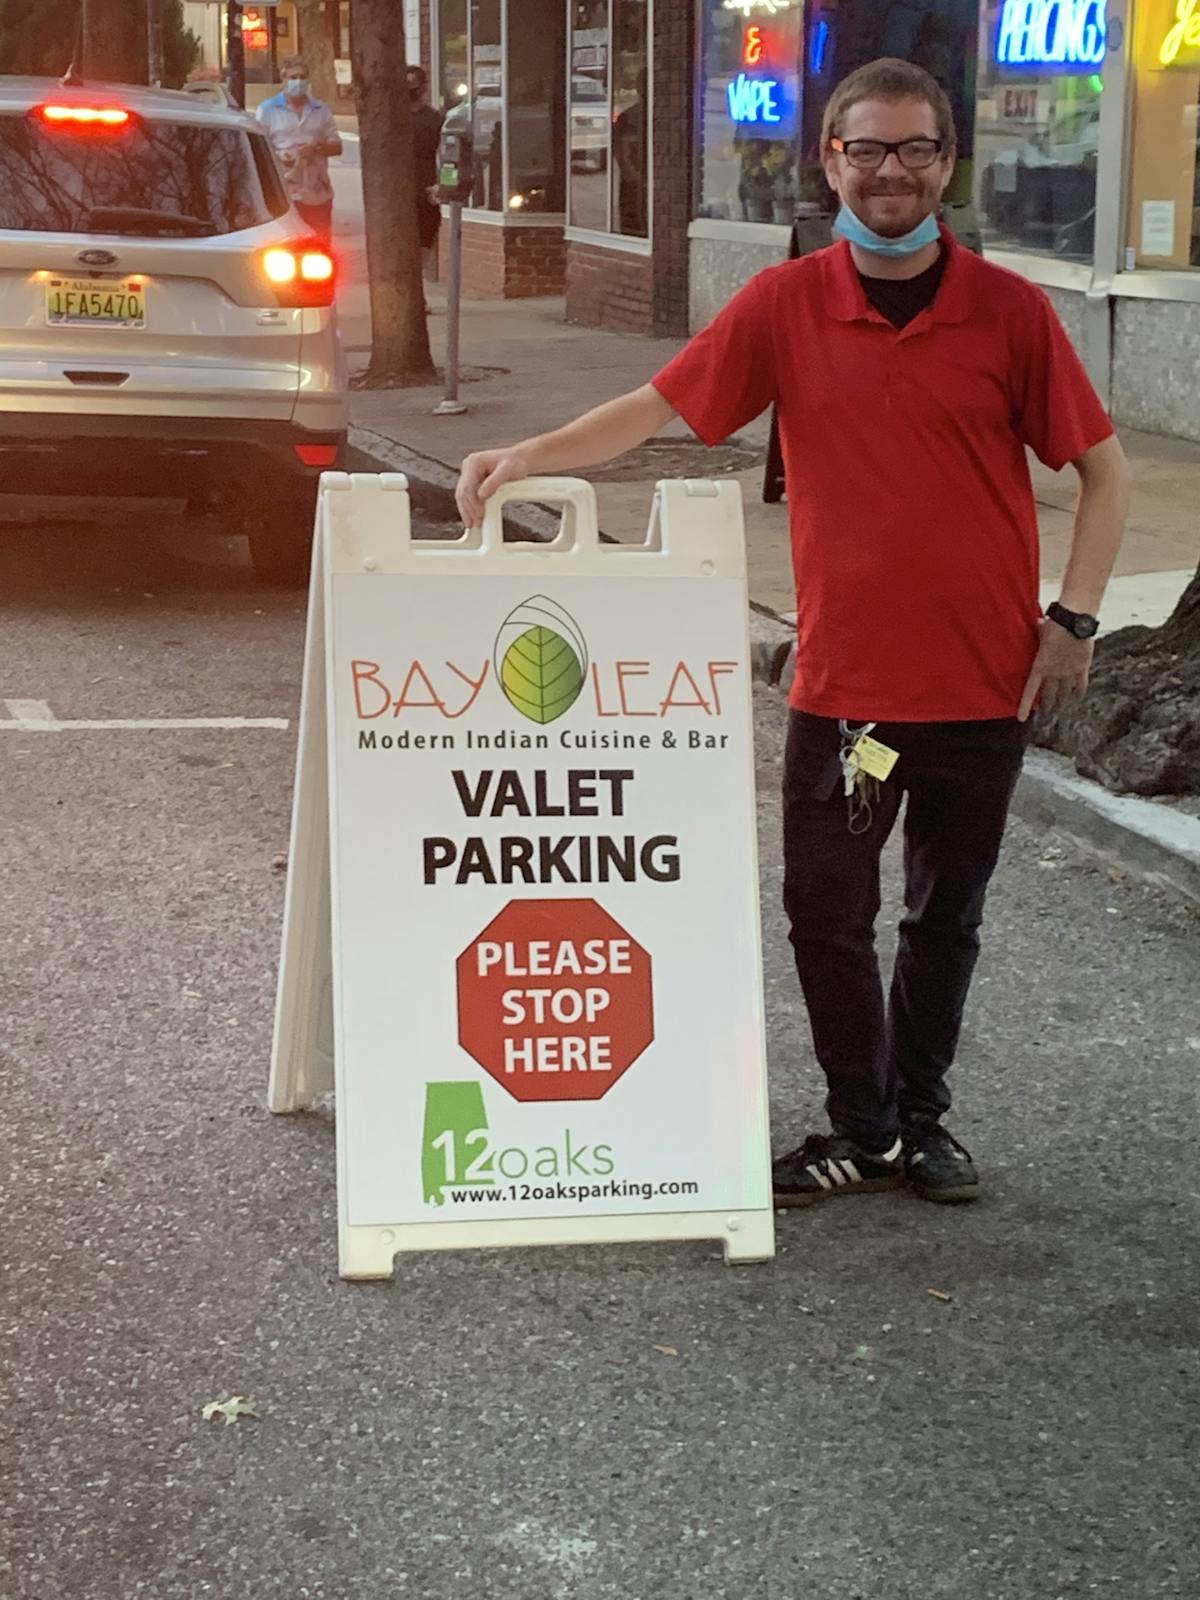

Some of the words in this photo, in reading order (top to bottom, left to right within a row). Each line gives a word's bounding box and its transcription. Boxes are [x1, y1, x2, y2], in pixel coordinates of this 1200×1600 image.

[728, 73, 780, 122] VAPE
[1004, 89, 1037, 118] EXIT
[54, 291, 139, 319] 1FA5470
[351, 659, 490, 719] BAY
[592, 661, 739, 717] LEAF
[358, 730, 455, 749] Modern
[467, 730, 549, 749] Indian
[560, 730, 650, 749] Cuisine
[662, 730, 677, 749] &
[688, 730, 729, 749] Bar
[451, 769, 635, 818] VALET
[422, 835, 681, 885] PARKING
[476, 939, 632, 977] PLEASE
[501, 987, 610, 1025] STOP
[503, 1035, 612, 1073] HERE
[431, 1128, 615, 1182] 12oaks
[451, 1179, 699, 1203] www.12oaksparking.com
